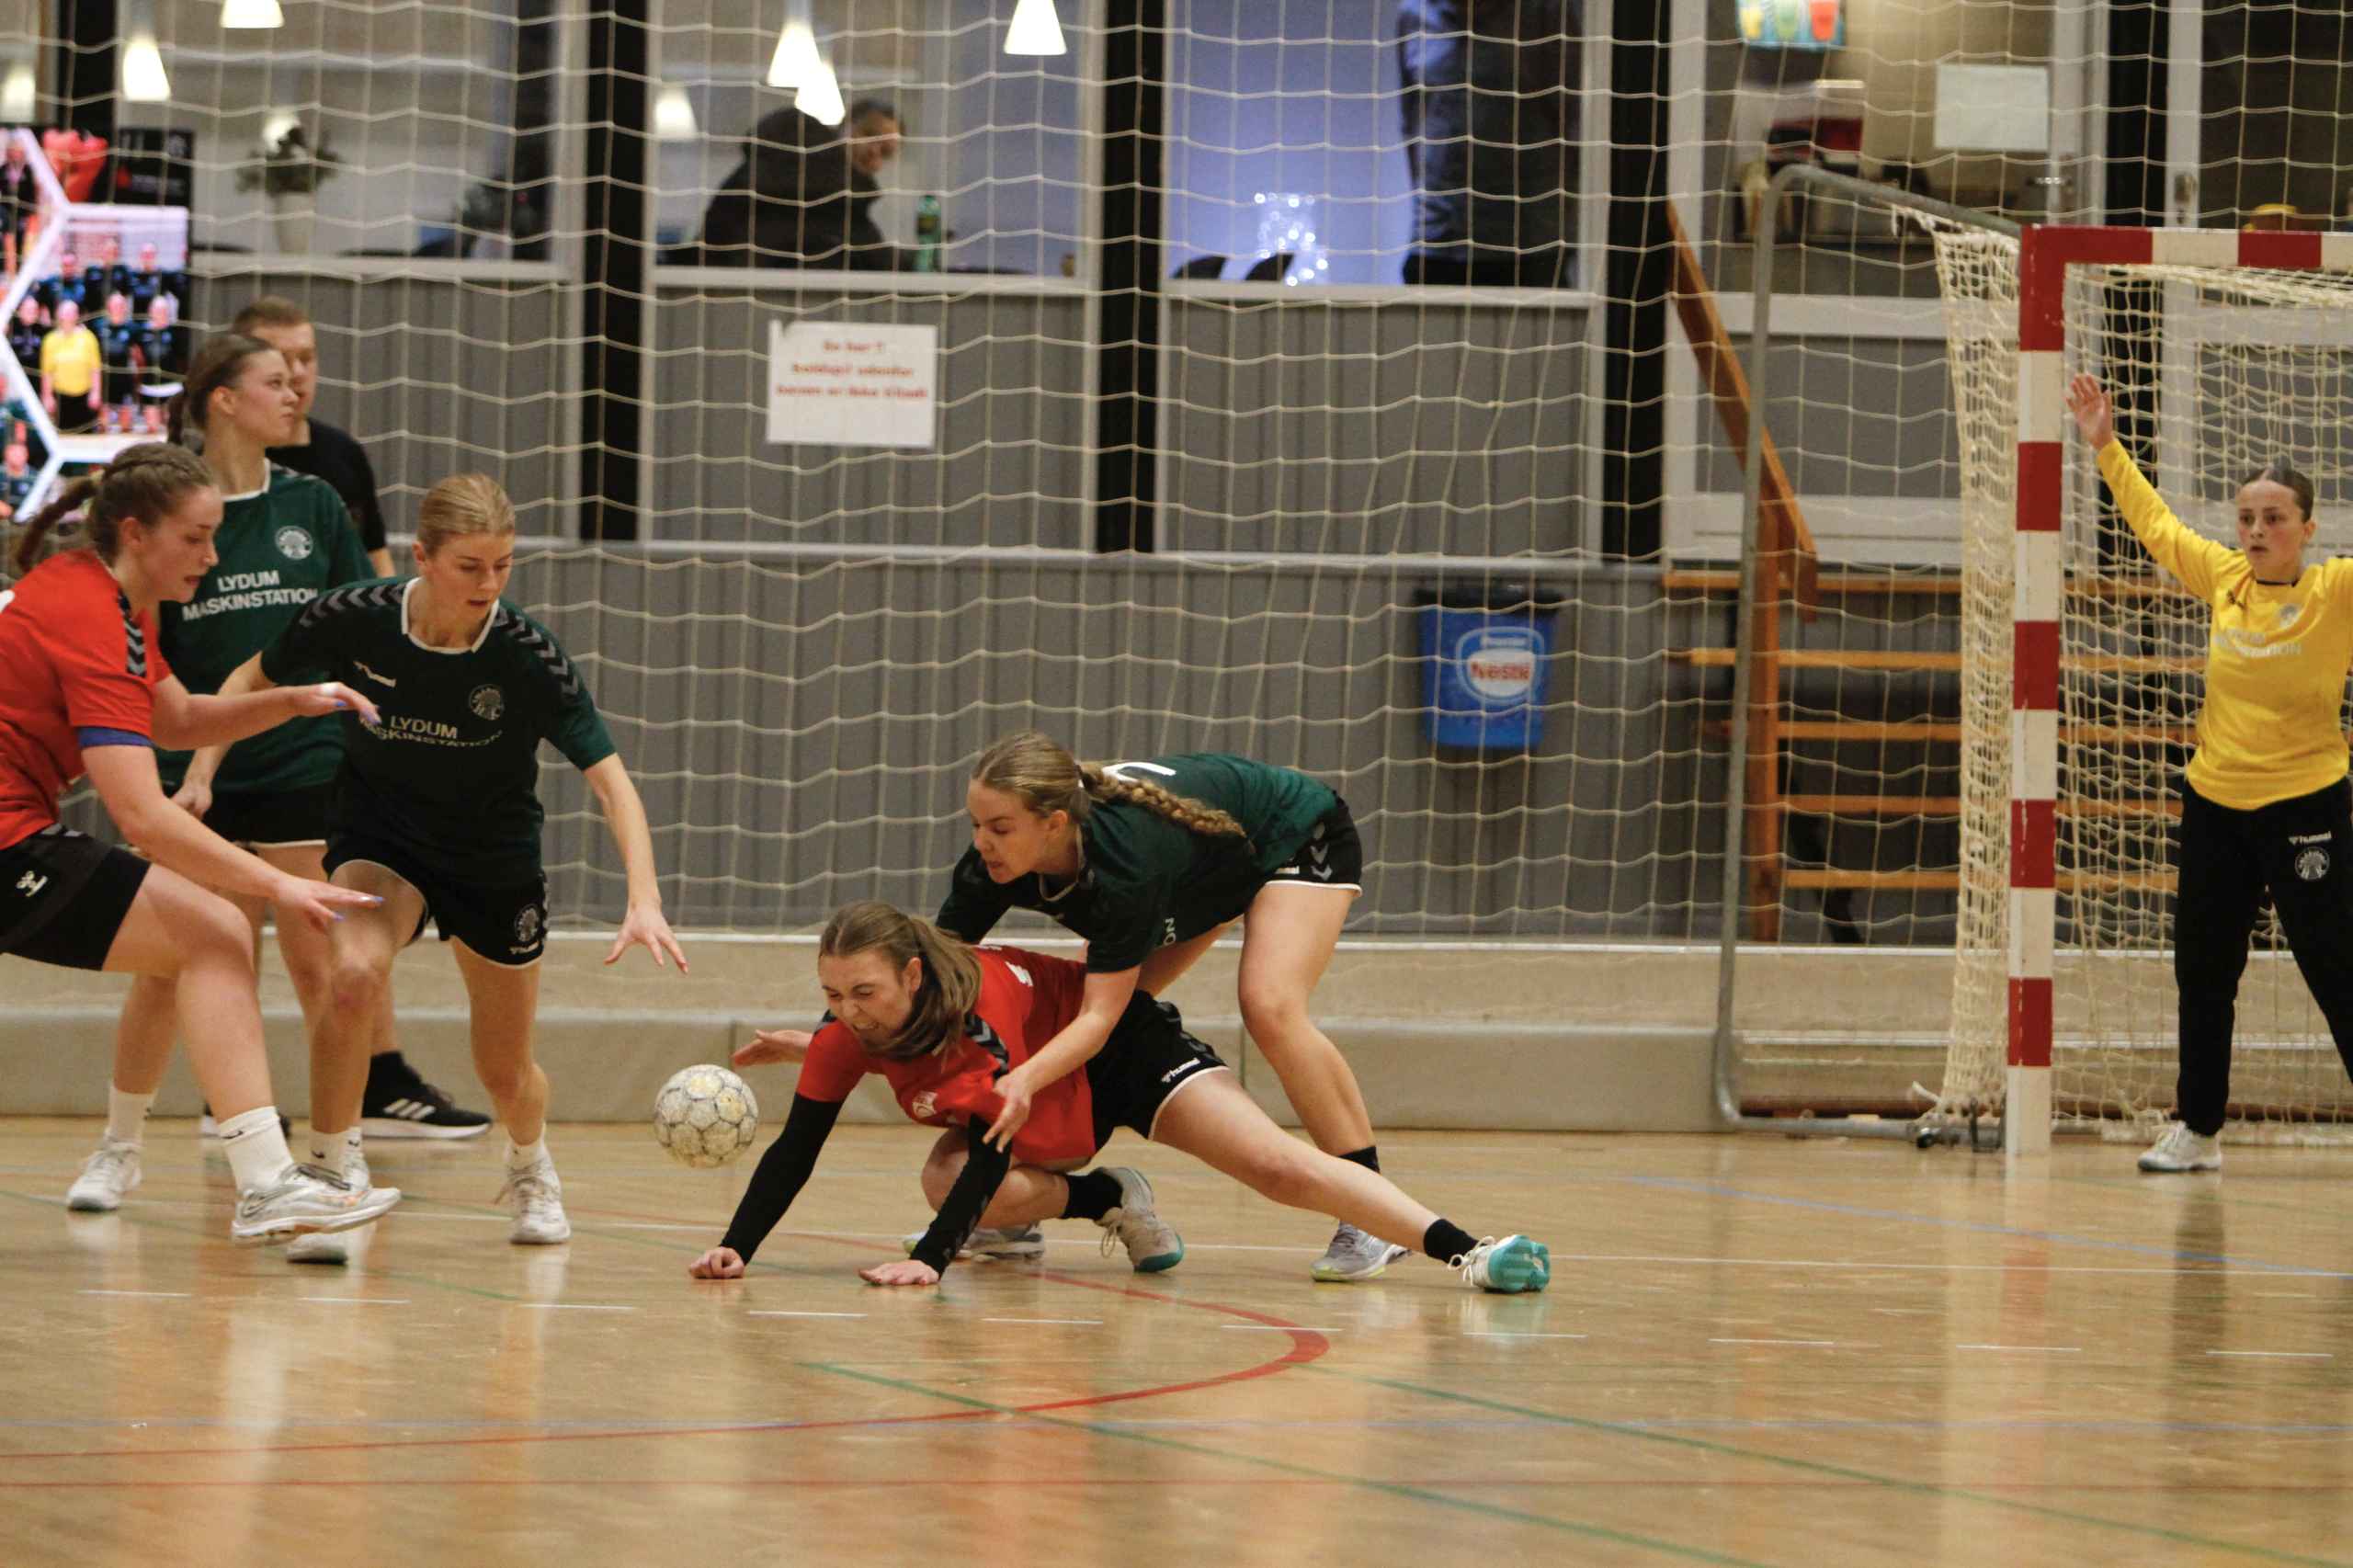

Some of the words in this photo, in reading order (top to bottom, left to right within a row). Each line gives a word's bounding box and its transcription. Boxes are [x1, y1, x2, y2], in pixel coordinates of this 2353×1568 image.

[217, 570, 280, 592] LYDUM
[182, 587, 318, 621] MASKINSTATION
[390, 715, 458, 739] LYDUM
